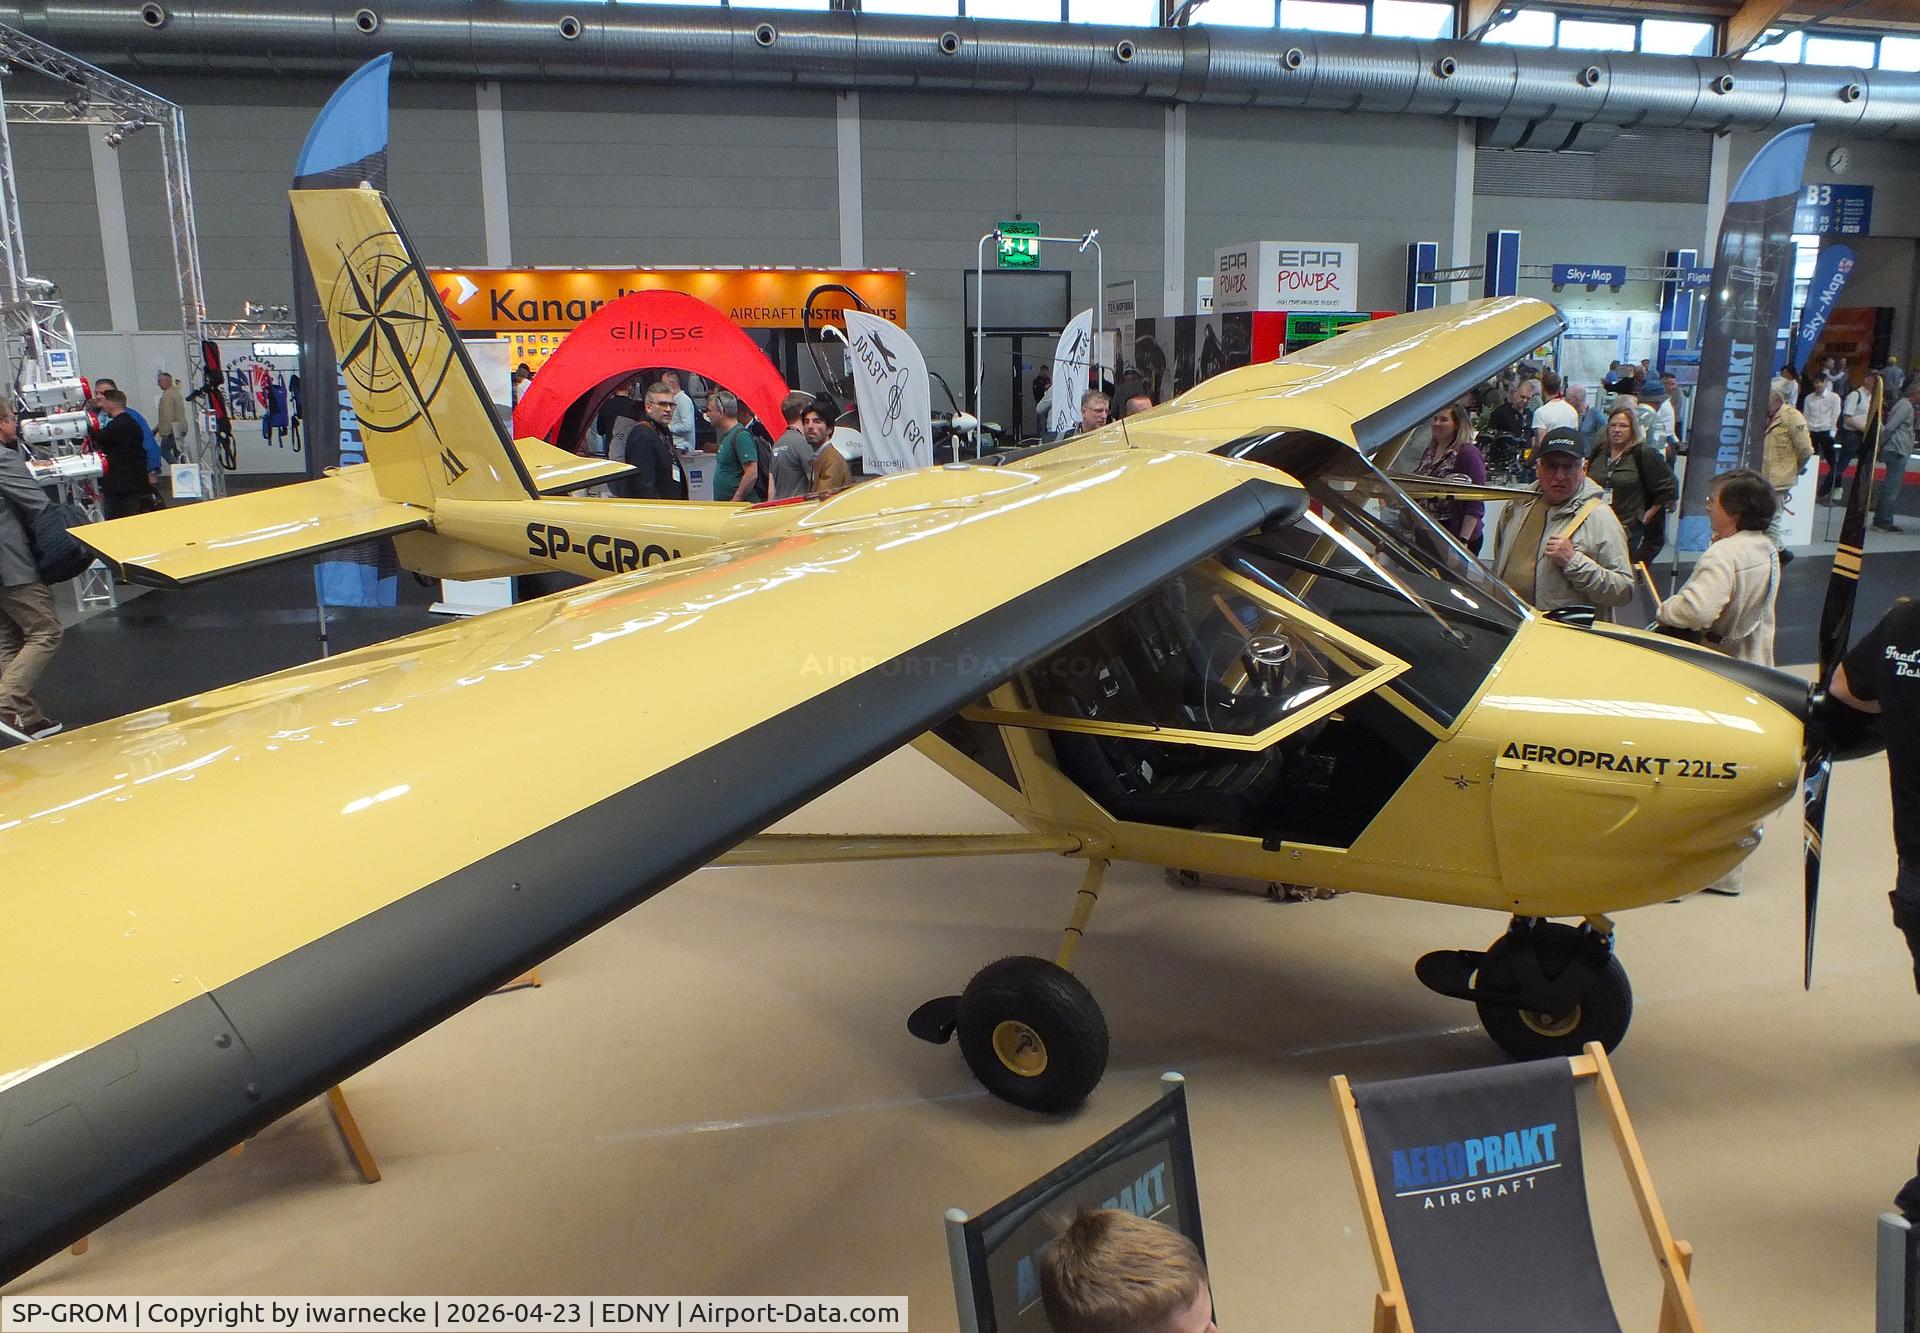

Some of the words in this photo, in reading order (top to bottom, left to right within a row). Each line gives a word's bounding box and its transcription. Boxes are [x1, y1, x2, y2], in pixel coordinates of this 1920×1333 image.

[1806, 185, 1831, 206] B3
[1278, 250, 1342, 268] EPA
[1219, 273, 1247, 294] POWER
[1277, 269, 1340, 293] POWER
[1566, 268, 1612, 283] Sky-Map
[1687, 273, 1711, 284] Flight
[730, 307, 797, 320] AIRCRAFT
[1802, 273, 1846, 341] Sky-Map
[610, 321, 704, 347] ellipse
[1715, 338, 1754, 476] EROPRAKT
[526, 522, 682, 574] SP-GRO
[1885, 645, 1920, 663] Fred'
[1502, 742, 1671, 775] AEROPRAKT
[1677, 759, 1738, 780] 22LS
[1391, 1123, 1557, 1188] AEROPRAKT
[1424, 1176, 1536, 1210] AIRCRAFT
